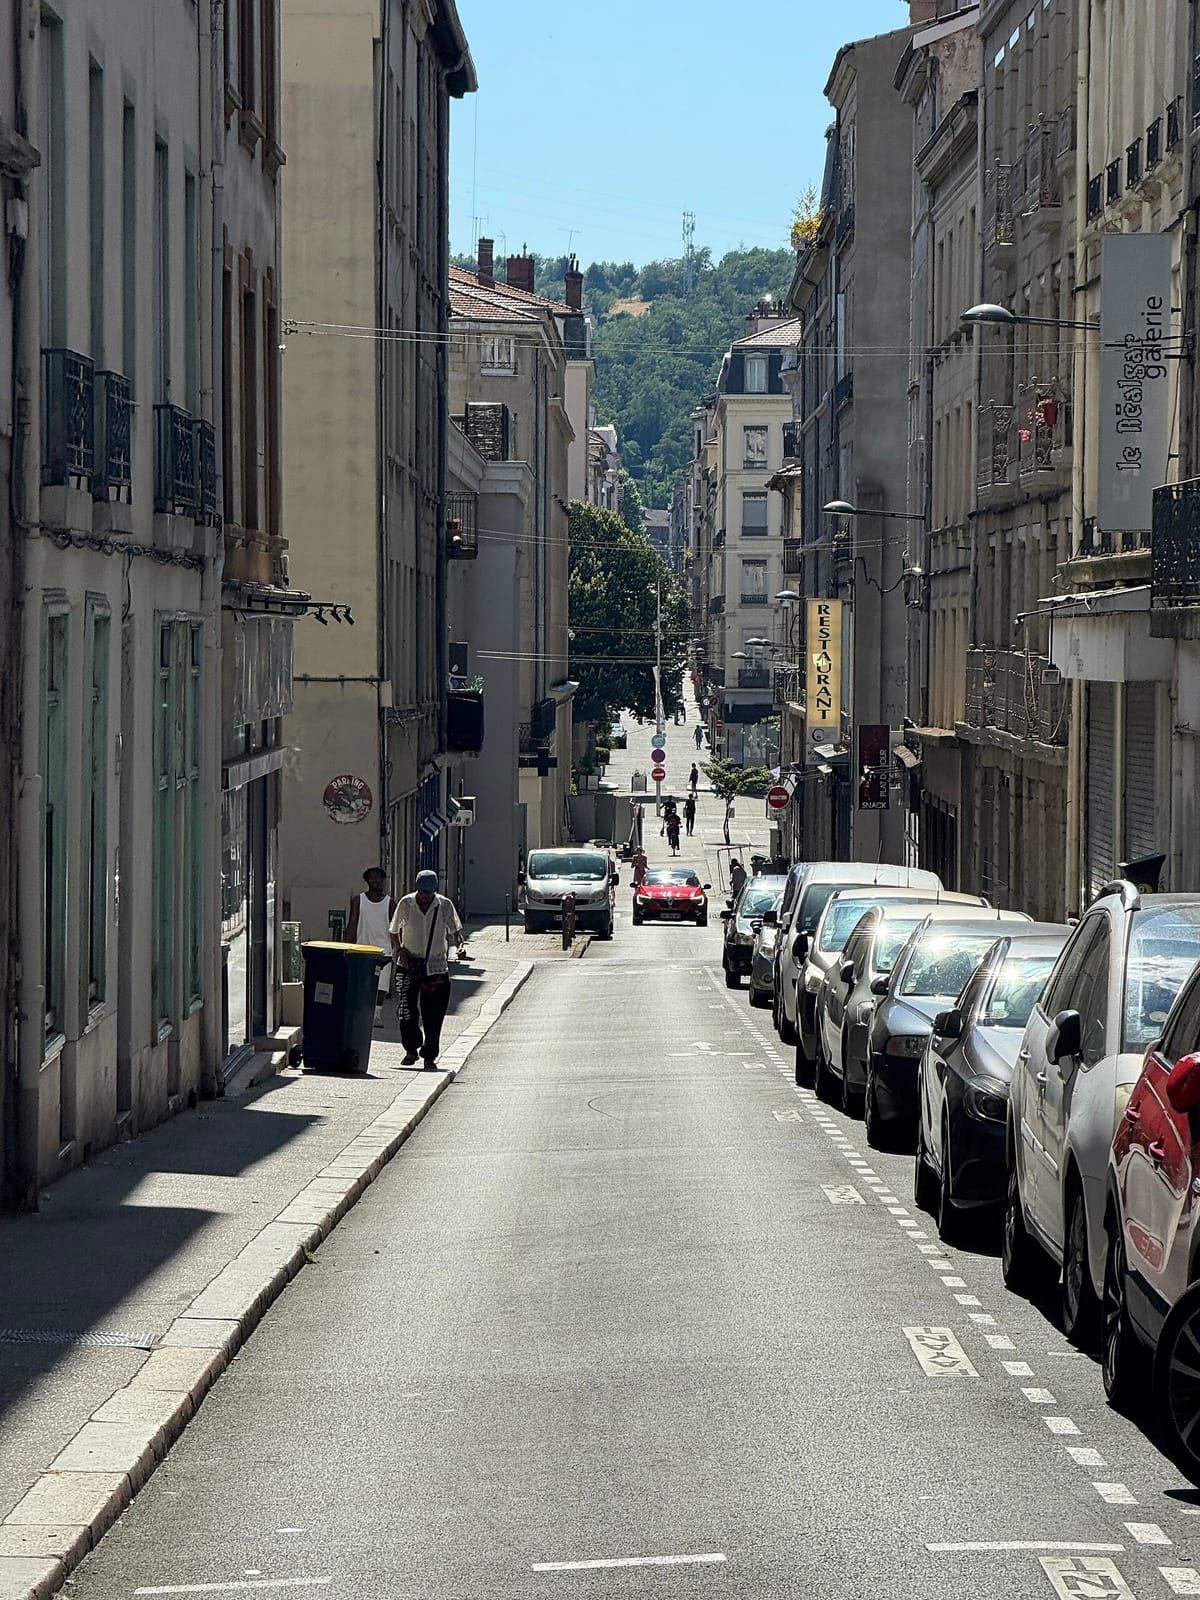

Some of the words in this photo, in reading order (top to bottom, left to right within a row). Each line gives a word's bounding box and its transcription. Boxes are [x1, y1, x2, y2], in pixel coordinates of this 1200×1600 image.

[1140, 295, 1167, 379] galerie
[1115, 446, 1141, 471] le
[816, 604, 832, 720] RESTAURANT
[879, 781, 887, 797] PLAT
[861, 801, 887, 809] SNACK
